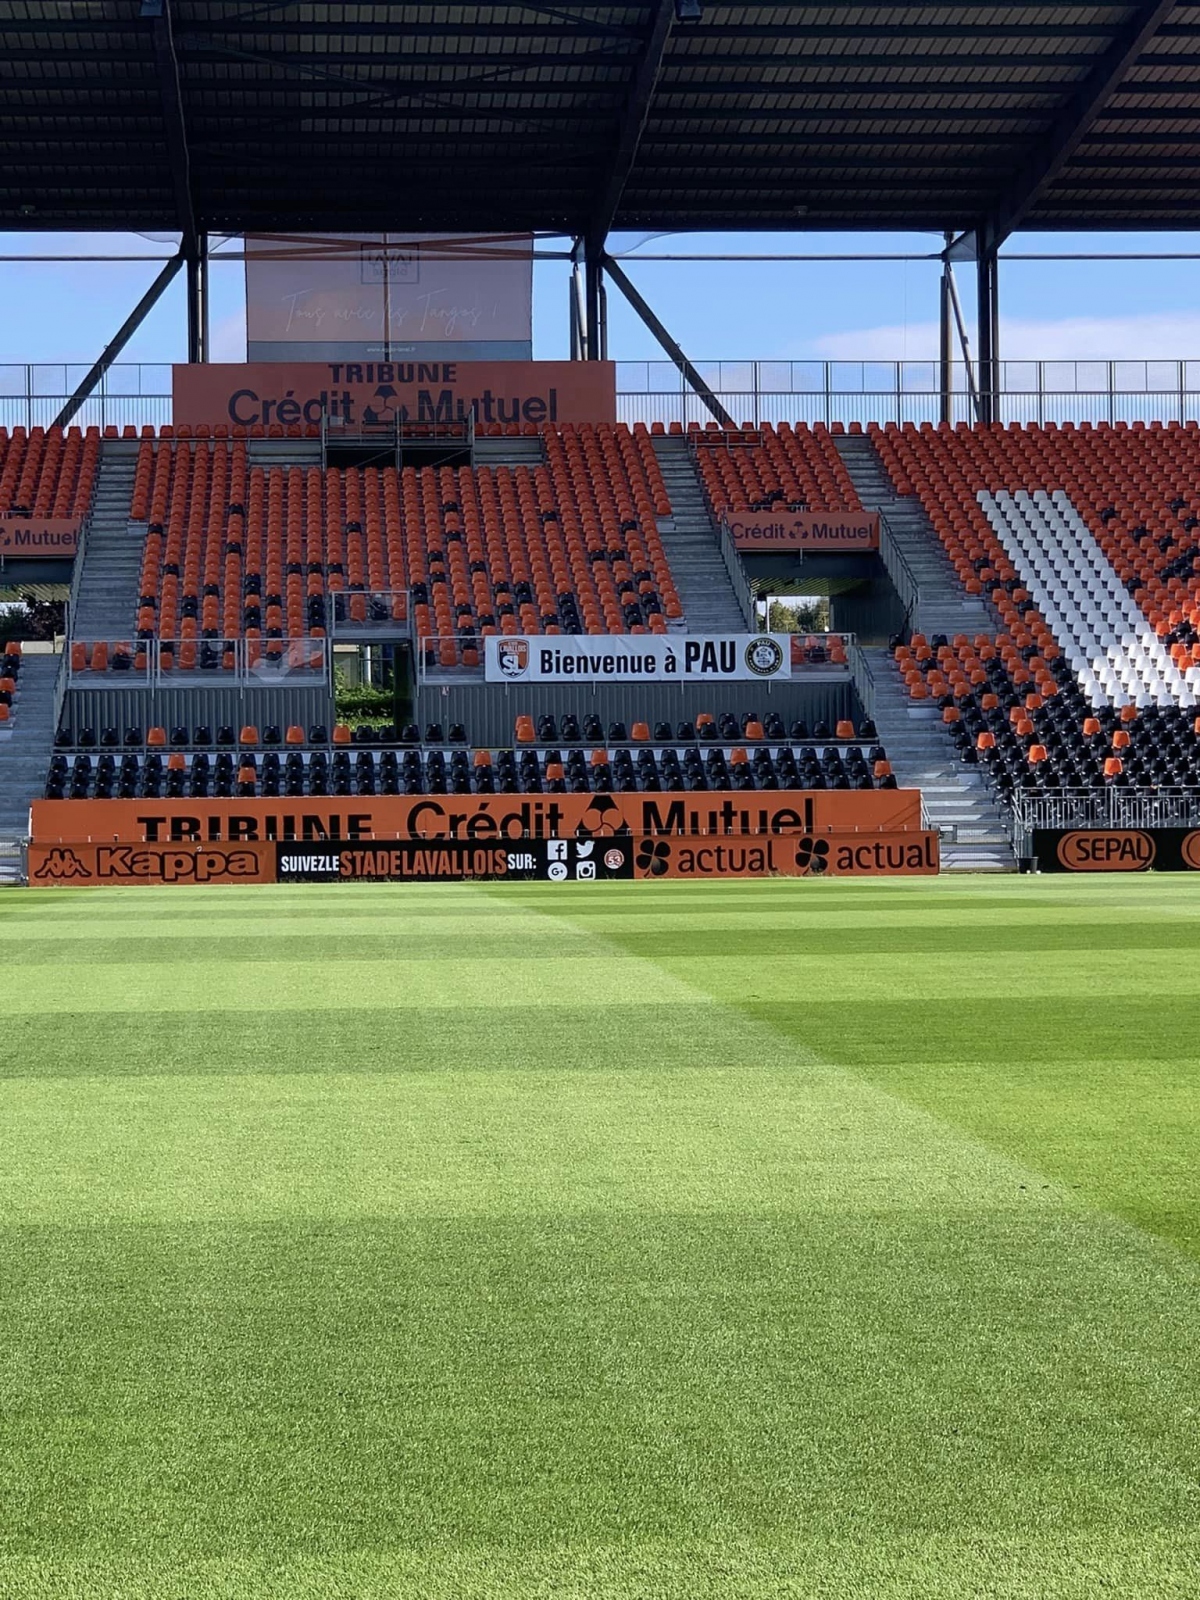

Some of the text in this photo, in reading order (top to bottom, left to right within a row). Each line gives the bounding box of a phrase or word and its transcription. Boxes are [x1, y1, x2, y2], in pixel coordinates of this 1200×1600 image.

[281, 288, 326, 332] Tous
[328, 363, 457, 384] TRIBUNE
[228, 387, 558, 426] Crédit Mutuel
[14, 529, 78, 546] Mutuel
[732, 523, 873, 540] Crédit Mutuel
[540, 649, 656, 674] Bienvenue
[664, 647, 676, 673] à
[684, 641, 736, 673] PAU
[407, 800, 565, 841] Crédit
[642, 797, 814, 836] Mutuel
[97, 847, 259, 881] Kappa
[507, 853, 537, 870] SUR:
[678, 840, 778, 873] actual
[837, 836, 936, 870] actual
[1076, 838, 1149, 861] SEPAL
